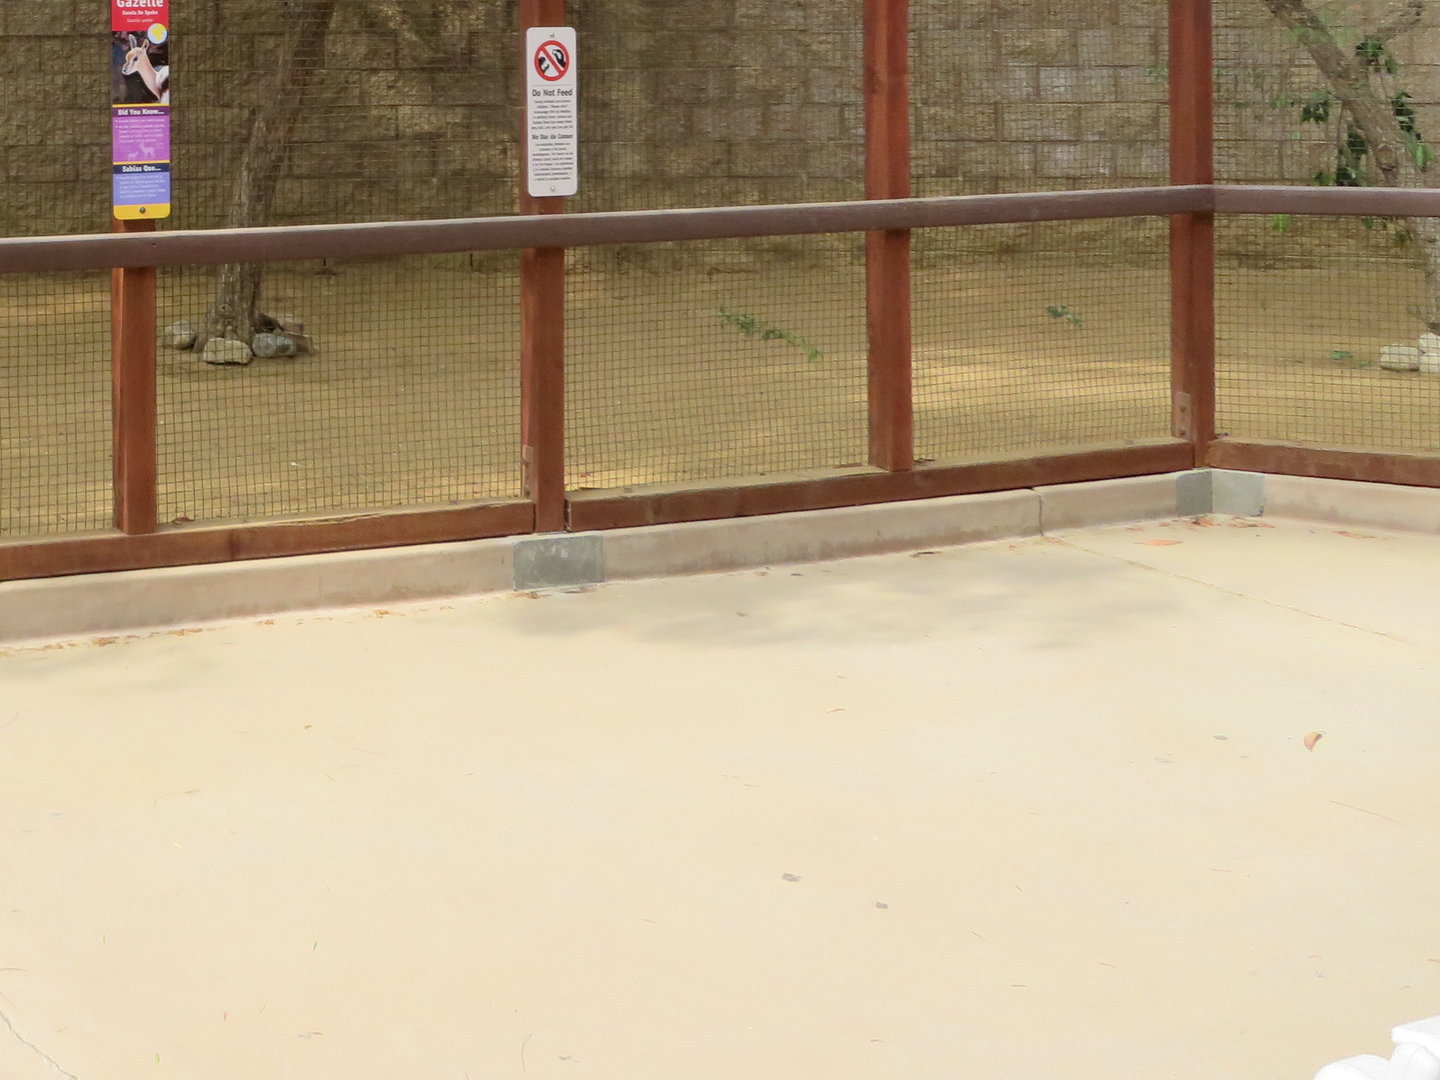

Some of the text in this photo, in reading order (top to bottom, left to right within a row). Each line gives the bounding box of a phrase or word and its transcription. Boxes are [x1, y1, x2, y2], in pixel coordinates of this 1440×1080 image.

[532, 88, 573, 97] Do Not Feed
